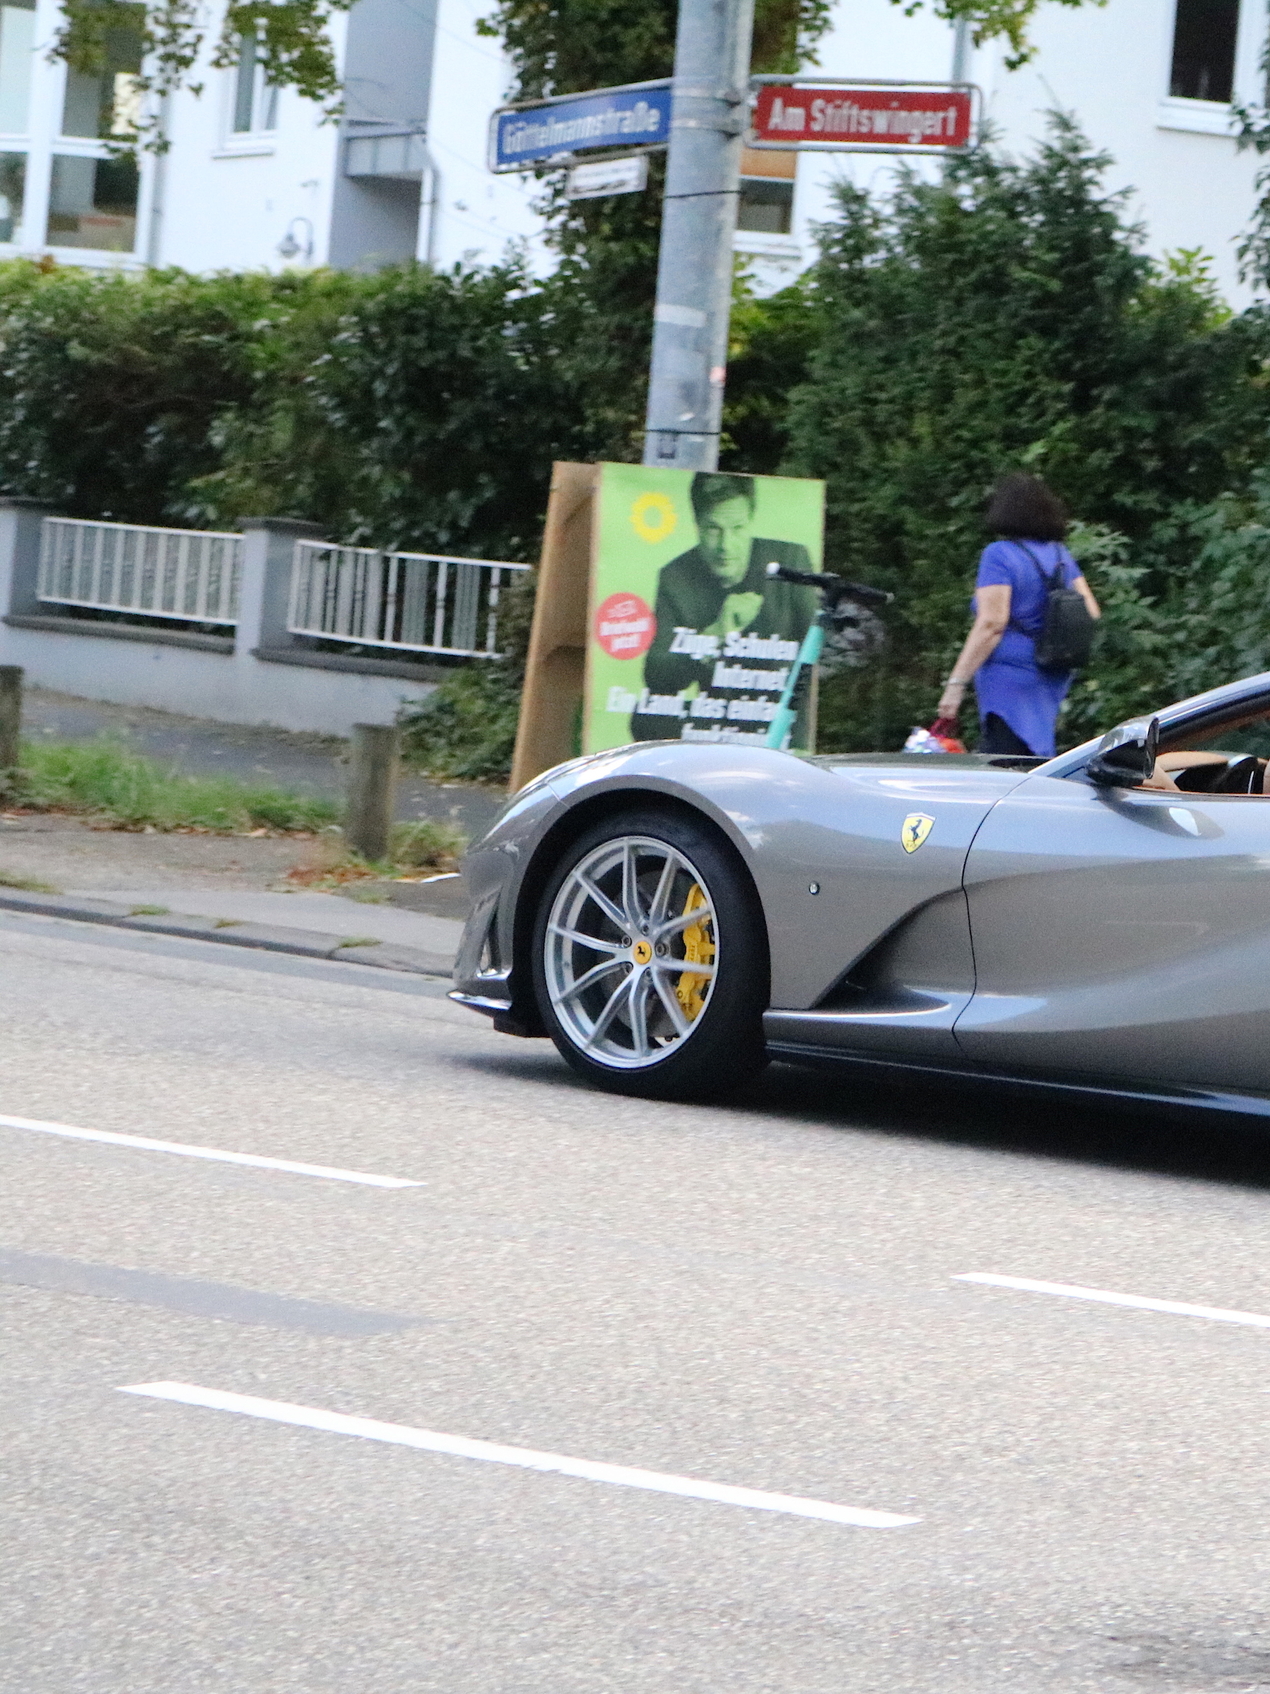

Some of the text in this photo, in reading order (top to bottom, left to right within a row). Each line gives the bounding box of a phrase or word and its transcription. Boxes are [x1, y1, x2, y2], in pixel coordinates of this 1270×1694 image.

[768, 97, 957, 144] Am Stiftswingert
[606, 686, 637, 713] Ein
[636, 687, 689, 719] Land,
[689, 691, 727, 719] das
